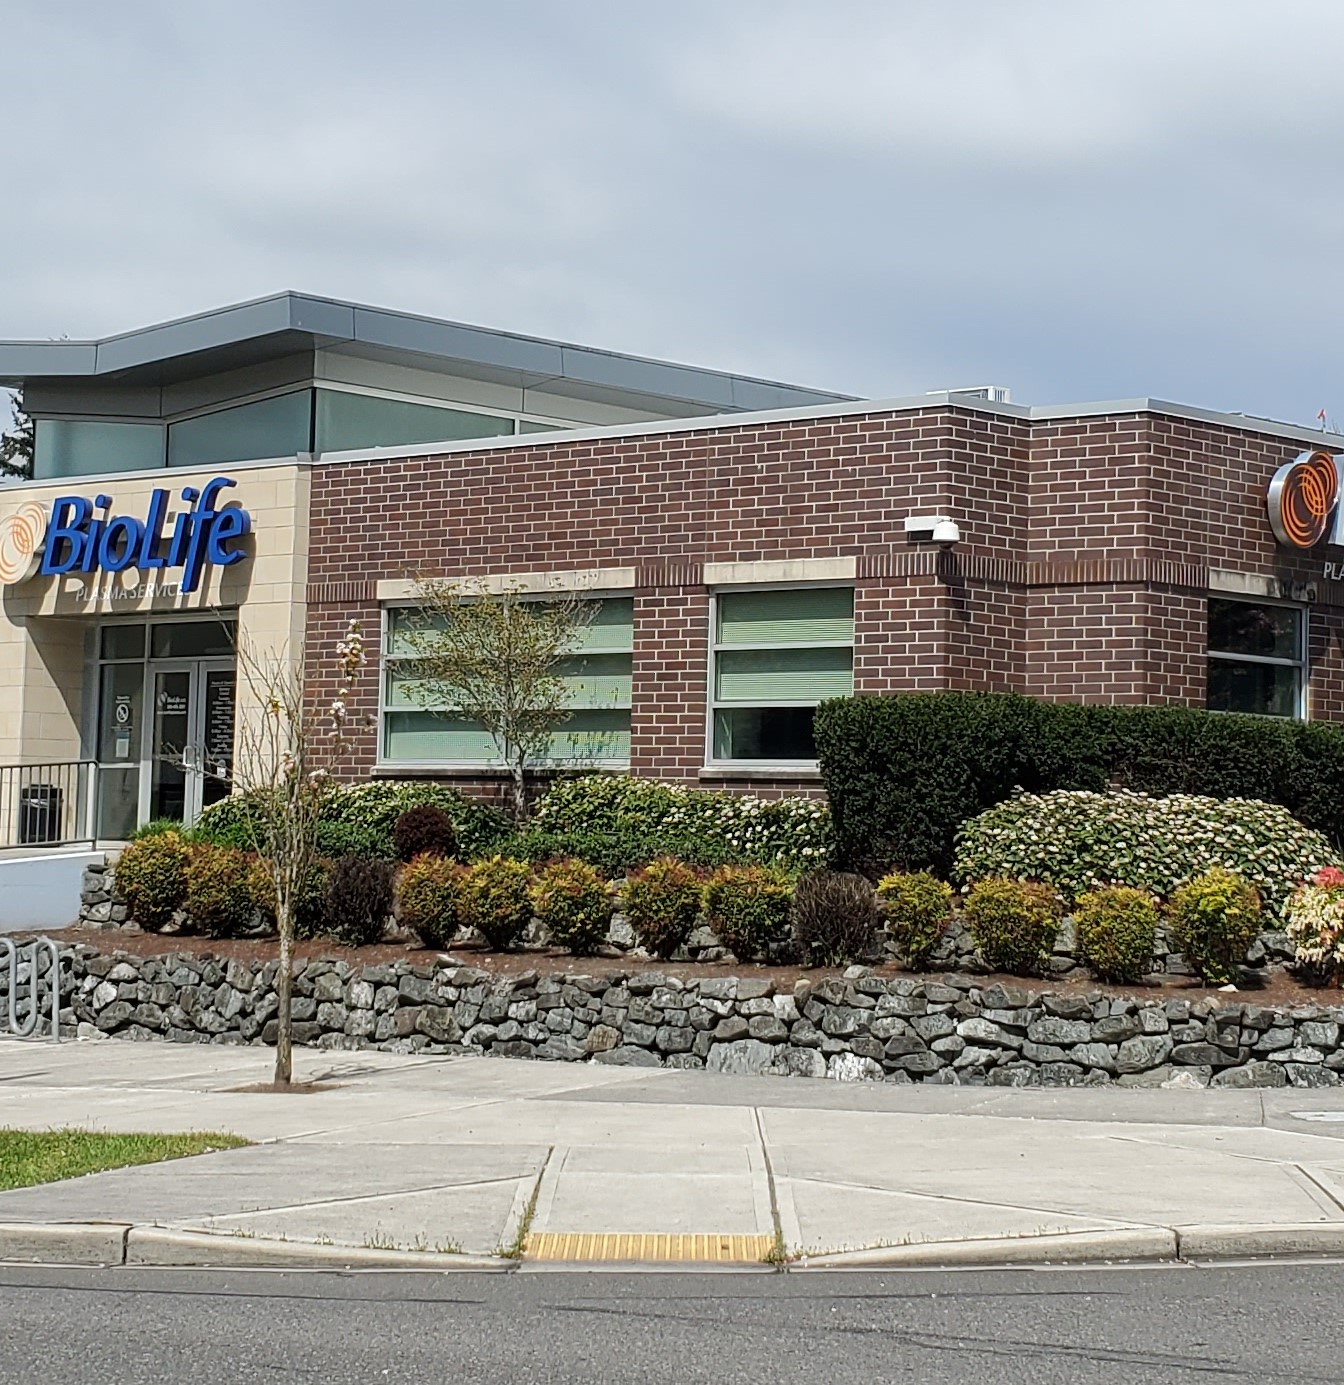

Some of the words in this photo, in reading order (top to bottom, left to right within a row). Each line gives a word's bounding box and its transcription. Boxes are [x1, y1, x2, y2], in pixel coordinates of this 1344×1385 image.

[41, 476, 251, 592] BioLife
[76, 584, 127, 601] PLASMA
[129, 581, 191, 599] SERVICE
